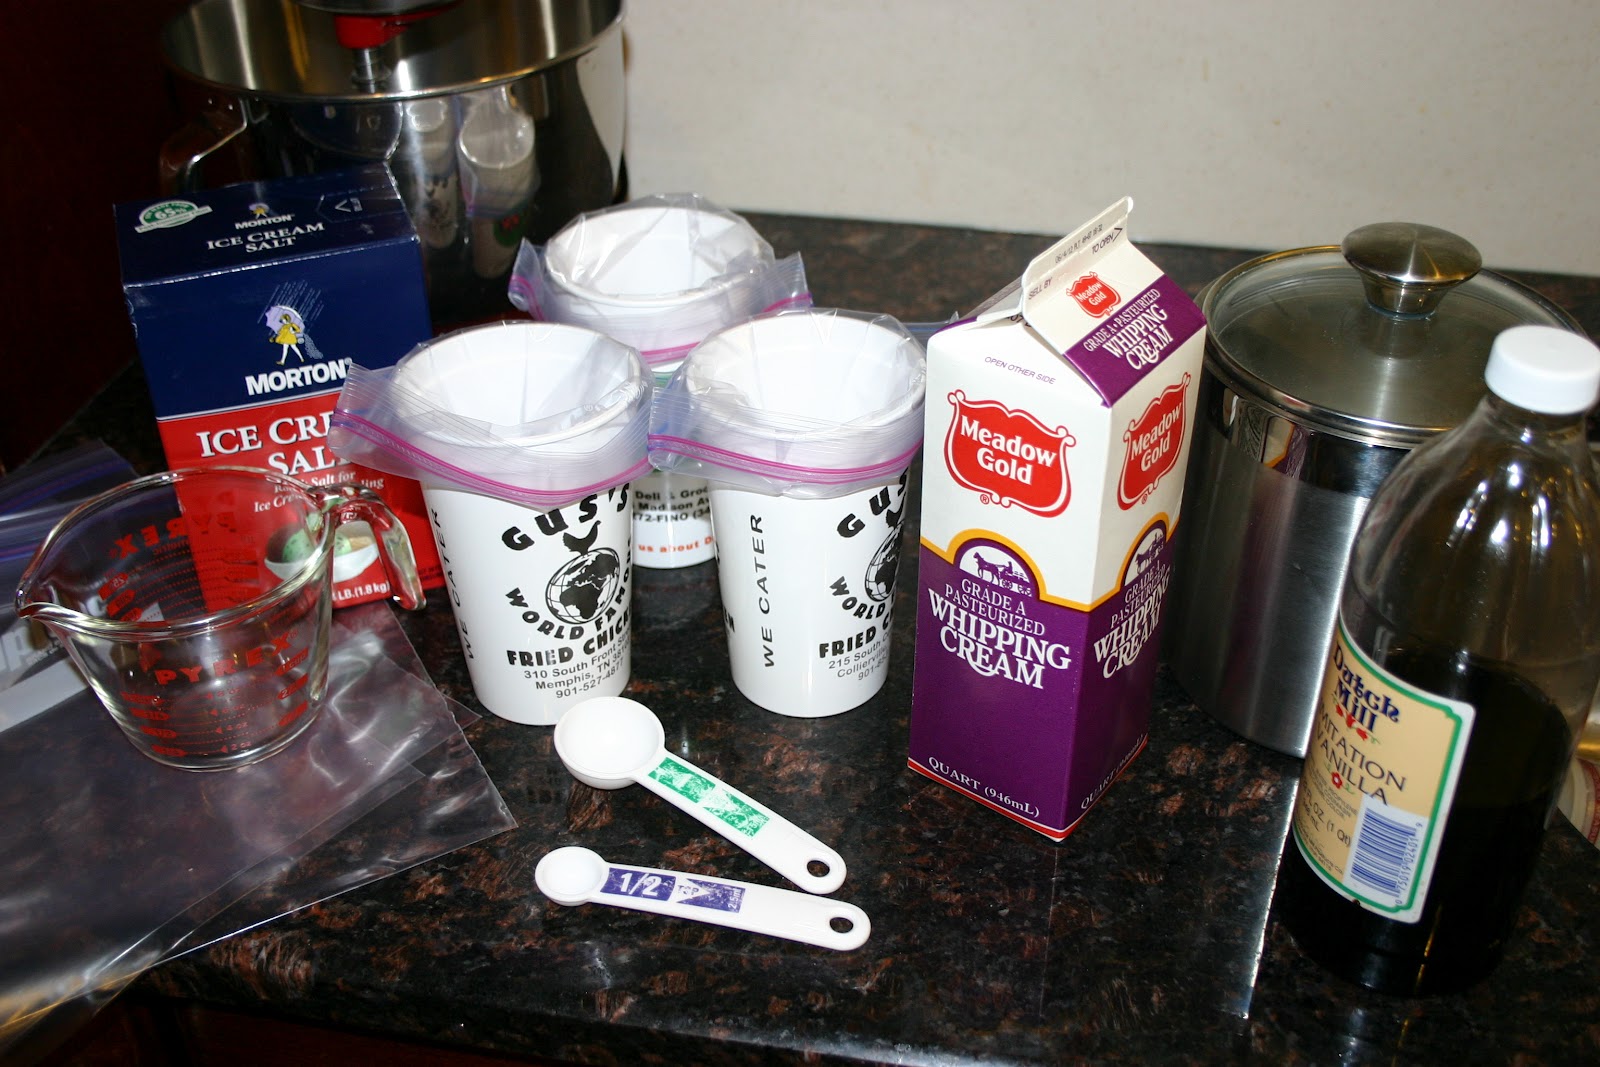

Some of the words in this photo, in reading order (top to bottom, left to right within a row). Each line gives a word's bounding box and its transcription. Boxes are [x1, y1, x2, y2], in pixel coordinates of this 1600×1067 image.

[206, 236, 243, 250] ICE
[247, 222, 325, 242] CREAM
[246, 236, 296, 253] SALT
[1075, 282, 1103, 303] Meadow
[1088, 291, 1107, 306] Gold
[1083, 328, 1111, 352] GRADE
[1106, 324, 1117, 334] A
[1114, 288, 1161, 328] PASTEURIZED
[1102, 303, 1168, 358] WHIPPING
[1126, 324, 1174, 370] CREAM
[984, 356, 1007, 369] OPEN
[1007, 364, 1036, 378] OTHER
[1036, 373, 1056, 385] SIDE
[196, 425, 262, 458] ICE
[960, 415, 1058, 468] Meadow
[1130, 400, 1182, 461] Meadow
[976, 447, 1033, 486] Gold
[1140, 435, 1171, 472] Gold
[337, 470, 356, 484] for
[635, 490, 661, 500] Deli
[254, 501, 271, 513] Ice
[638, 544, 654, 552] us
[749, 514, 771, 615] CATER
[829, 575, 886, 620] WORLD
[961, 578, 1012, 609] GRADE
[1016, 600, 1026, 616] A
[1125, 566, 1154, 604] GRADE
[505, 587, 585, 640] WORLD
[927, 587, 1072, 671] WHIPPING
[944, 583, 1045, 637] PASTEURIZED
[1093, 574, 1170, 663] WHIPPING
[154, 631, 292, 686] PYREX
[460, 623, 474, 660] WE
[506, 646, 574, 668] FRIED
[760, 626, 775, 668] WE
[818, 625, 876, 659] FRIED
[828, 656, 851, 670] 215
[854, 640, 881, 662] South
[940, 626, 1044, 690] CREAM
[1103, 600, 1162, 679] CREAM
[524, 670, 548, 679] 310
[552, 661, 588, 678] South
[591, 644, 617, 666] Front
[535, 673, 594, 691] Memphis,
[597, 660, 611, 674] TN
[1333, 641, 1400, 724] Dutch
[1334, 675, 1378, 733] Mill
[1316, 721, 1388, 806] VANILLA
[928, 756, 981, 791] QUART
[984, 784, 1040, 819] (946mL)
[620, 872, 662, 897] 1/2
